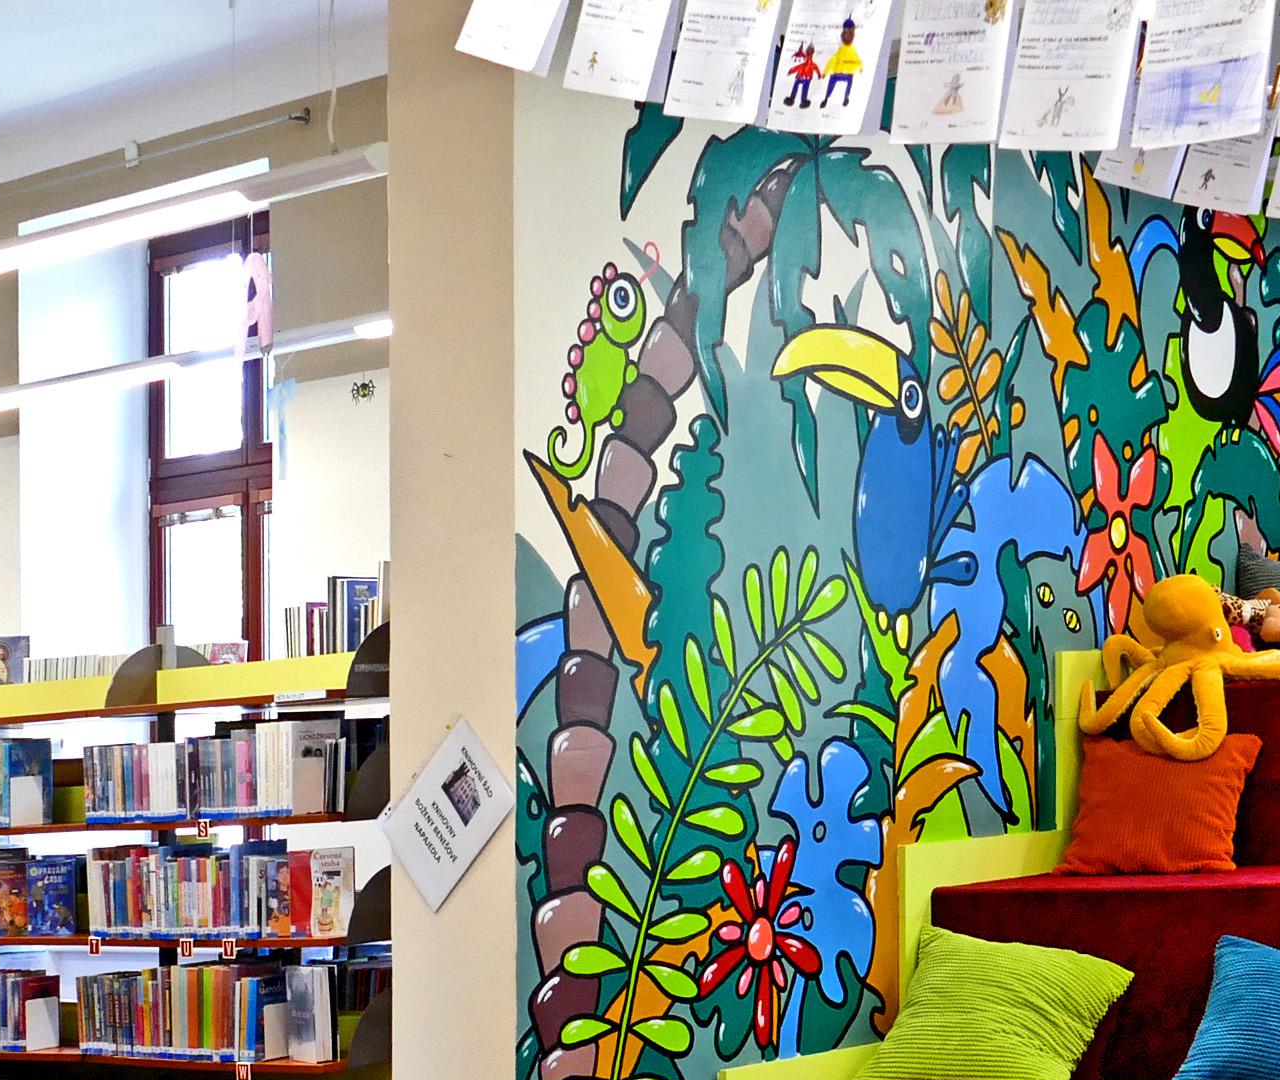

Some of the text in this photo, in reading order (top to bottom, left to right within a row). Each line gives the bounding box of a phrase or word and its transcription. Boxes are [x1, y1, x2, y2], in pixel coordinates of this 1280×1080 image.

[460, 746, 483, 782] KNIHOVNÍ
[199, 823, 207, 837] S
[414, 798, 458, 863] BOŽENY BENEŠOVÉ
[431, 801, 456, 839] KNIHOVNY
[413, 821, 441, 864] NAPAJEDLA
[183, 942, 191, 956] U
[224, 941, 234, 956] V
[238, 1064, 248, 1080] W
